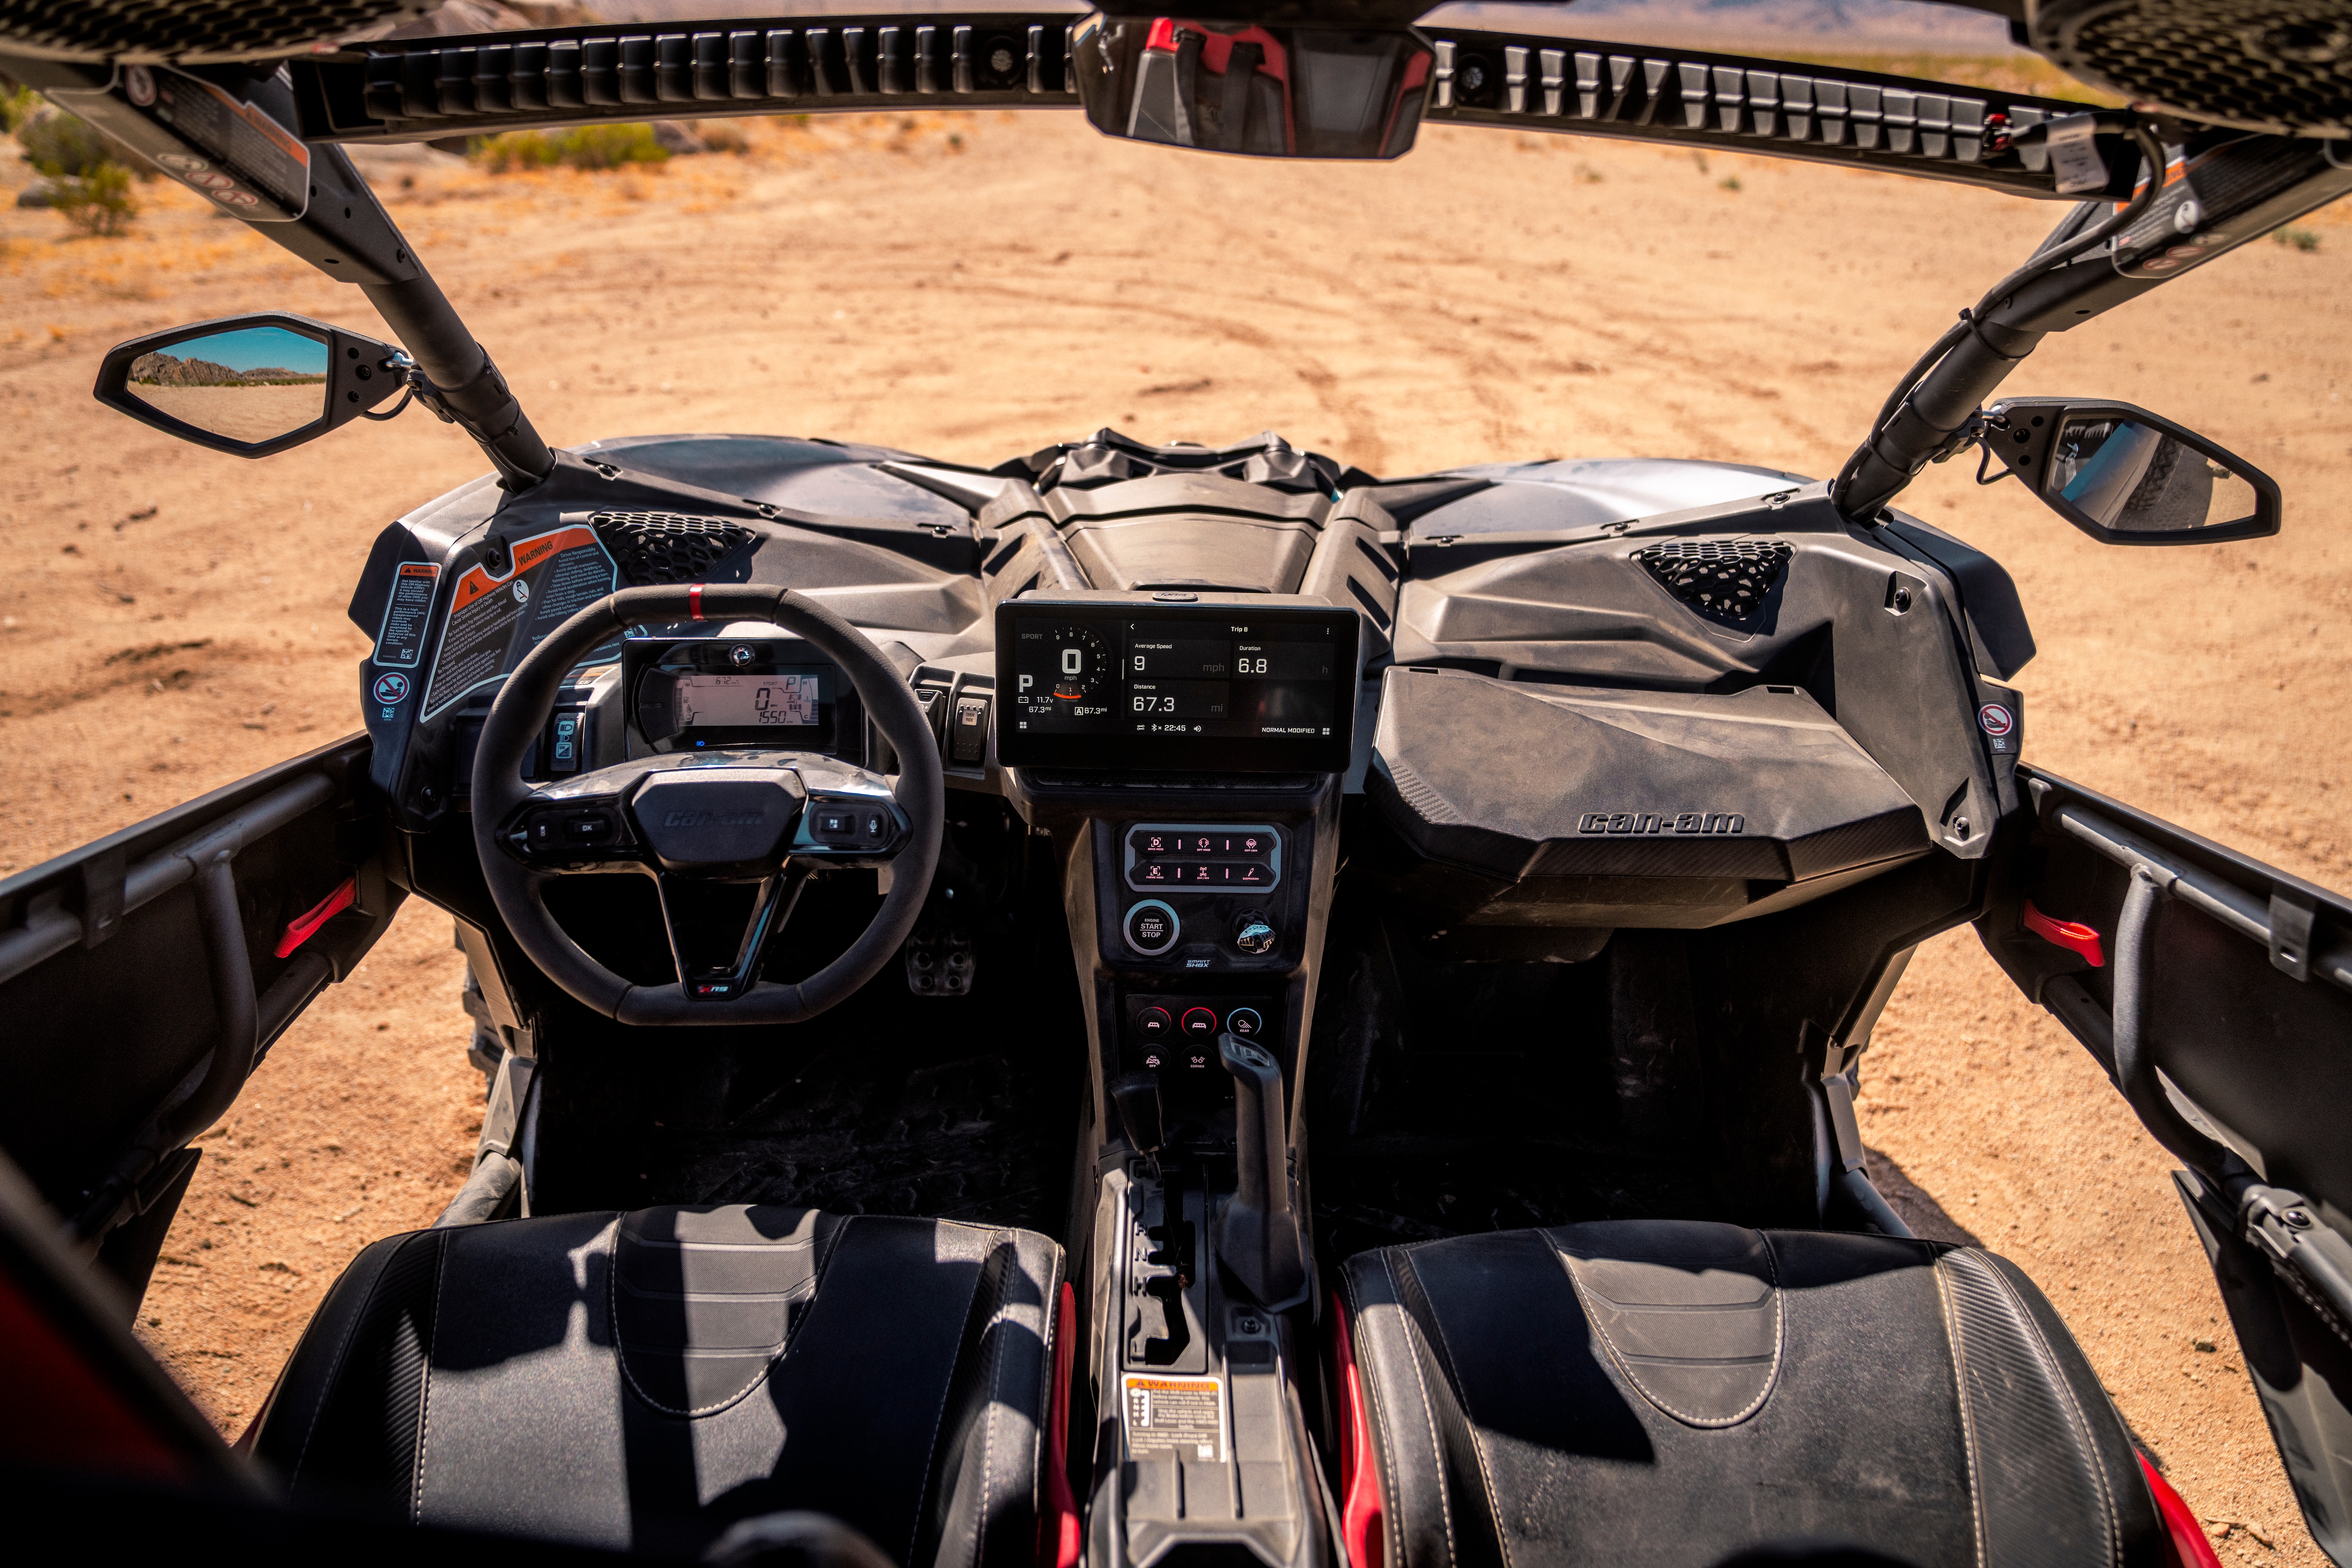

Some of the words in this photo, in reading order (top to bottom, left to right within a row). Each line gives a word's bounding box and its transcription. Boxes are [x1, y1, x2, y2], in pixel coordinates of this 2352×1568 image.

[518, 541, 553, 565] WARNING
[1062, 649, 1081, 674] 0
[1135, 656, 1145, 671] 9
[1203, 663, 1224, 673] mph
[1239, 658, 1267, 673] 6.8
[786, 677, 796, 690] P
[1019, 675, 1033, 692] P
[755, 688, 771, 710] 0
[1134, 697, 1175, 712] 67.3
[1211, 704, 1223, 712] mi
[759, 711, 787, 724] 1550
[1578, 812, 1744, 834] can-am
[698, 985, 729, 993] XRS
[1135, 1221, 1148, 1235] R
[1135, 1247, 1147, 1261] N
[1133, 1276, 1147, 1297] H
